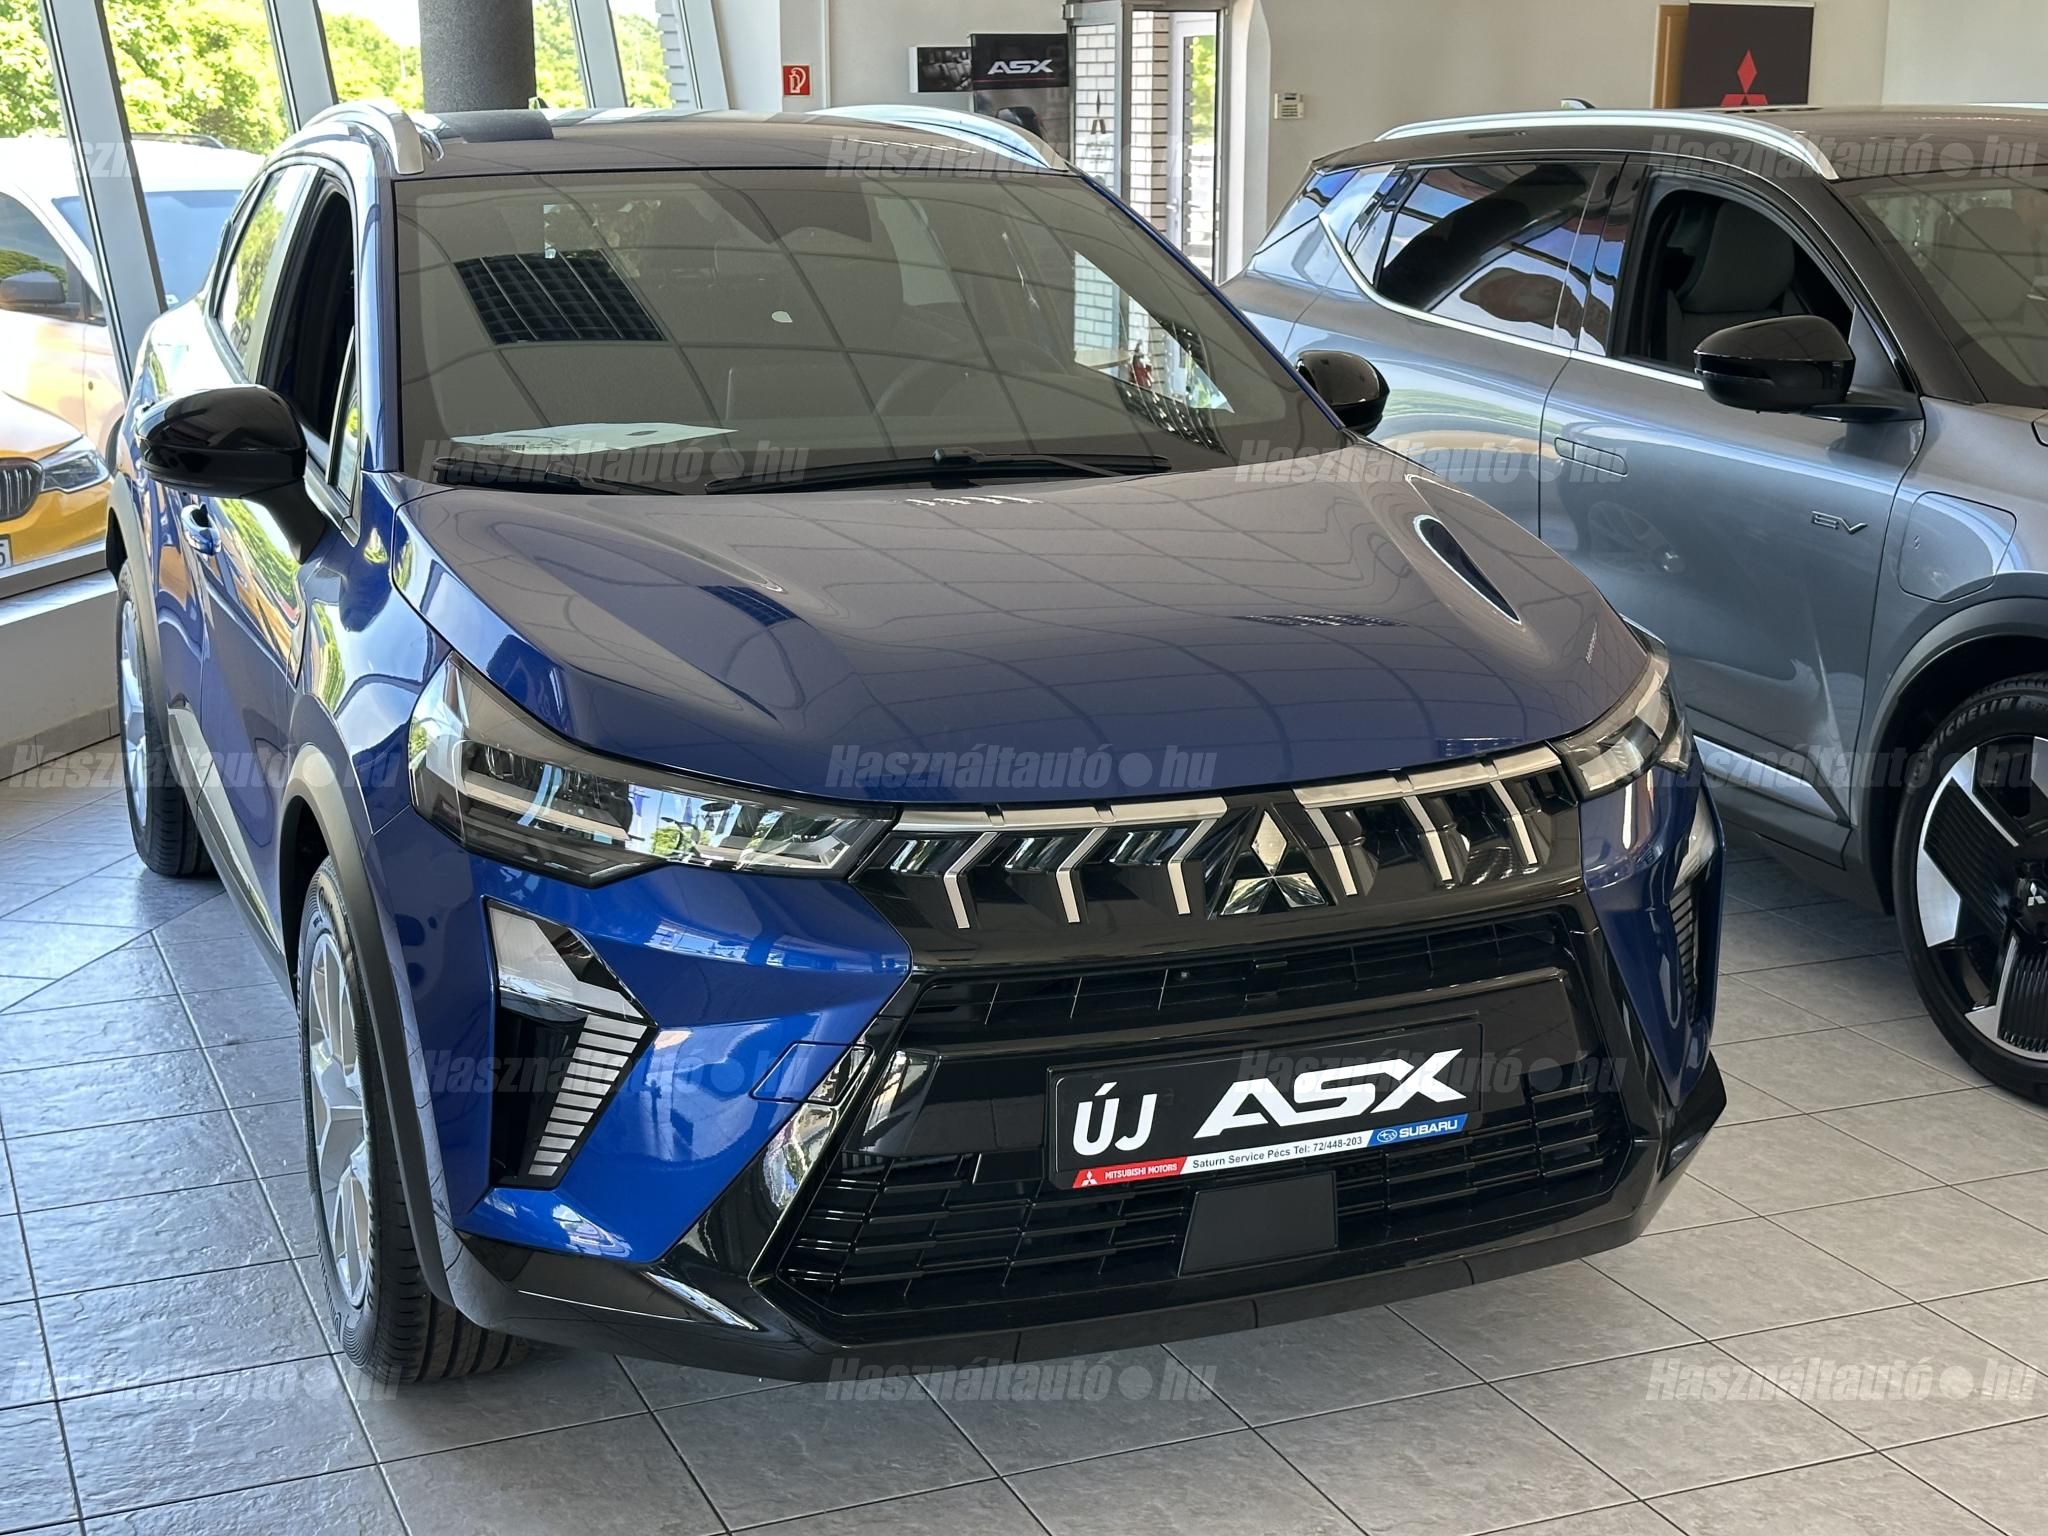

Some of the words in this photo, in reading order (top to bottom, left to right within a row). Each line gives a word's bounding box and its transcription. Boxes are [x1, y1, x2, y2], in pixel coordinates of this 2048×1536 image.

[987, 59, 1054, 75] ASX
[1811, 510, 1868, 535] EV
[1073, 1082, 1157, 1156] ÚJ
[1193, 1049, 1466, 1139] ASX
[1399, 1120, 1458, 1138] SUBARU
[1193, 1155, 1226, 1168] Saturn
[1229, 1152, 1264, 1164] Service
[1267, 1148, 1291, 1158] Pécs
[1294, 1145, 1311, 1155] Tel:
[1313, 1136, 1363, 1151] 72/448-203
[1105, 1166, 1146, 1180] MITSUBISHI
[1148, 1163, 1178, 1175] MOTORS
